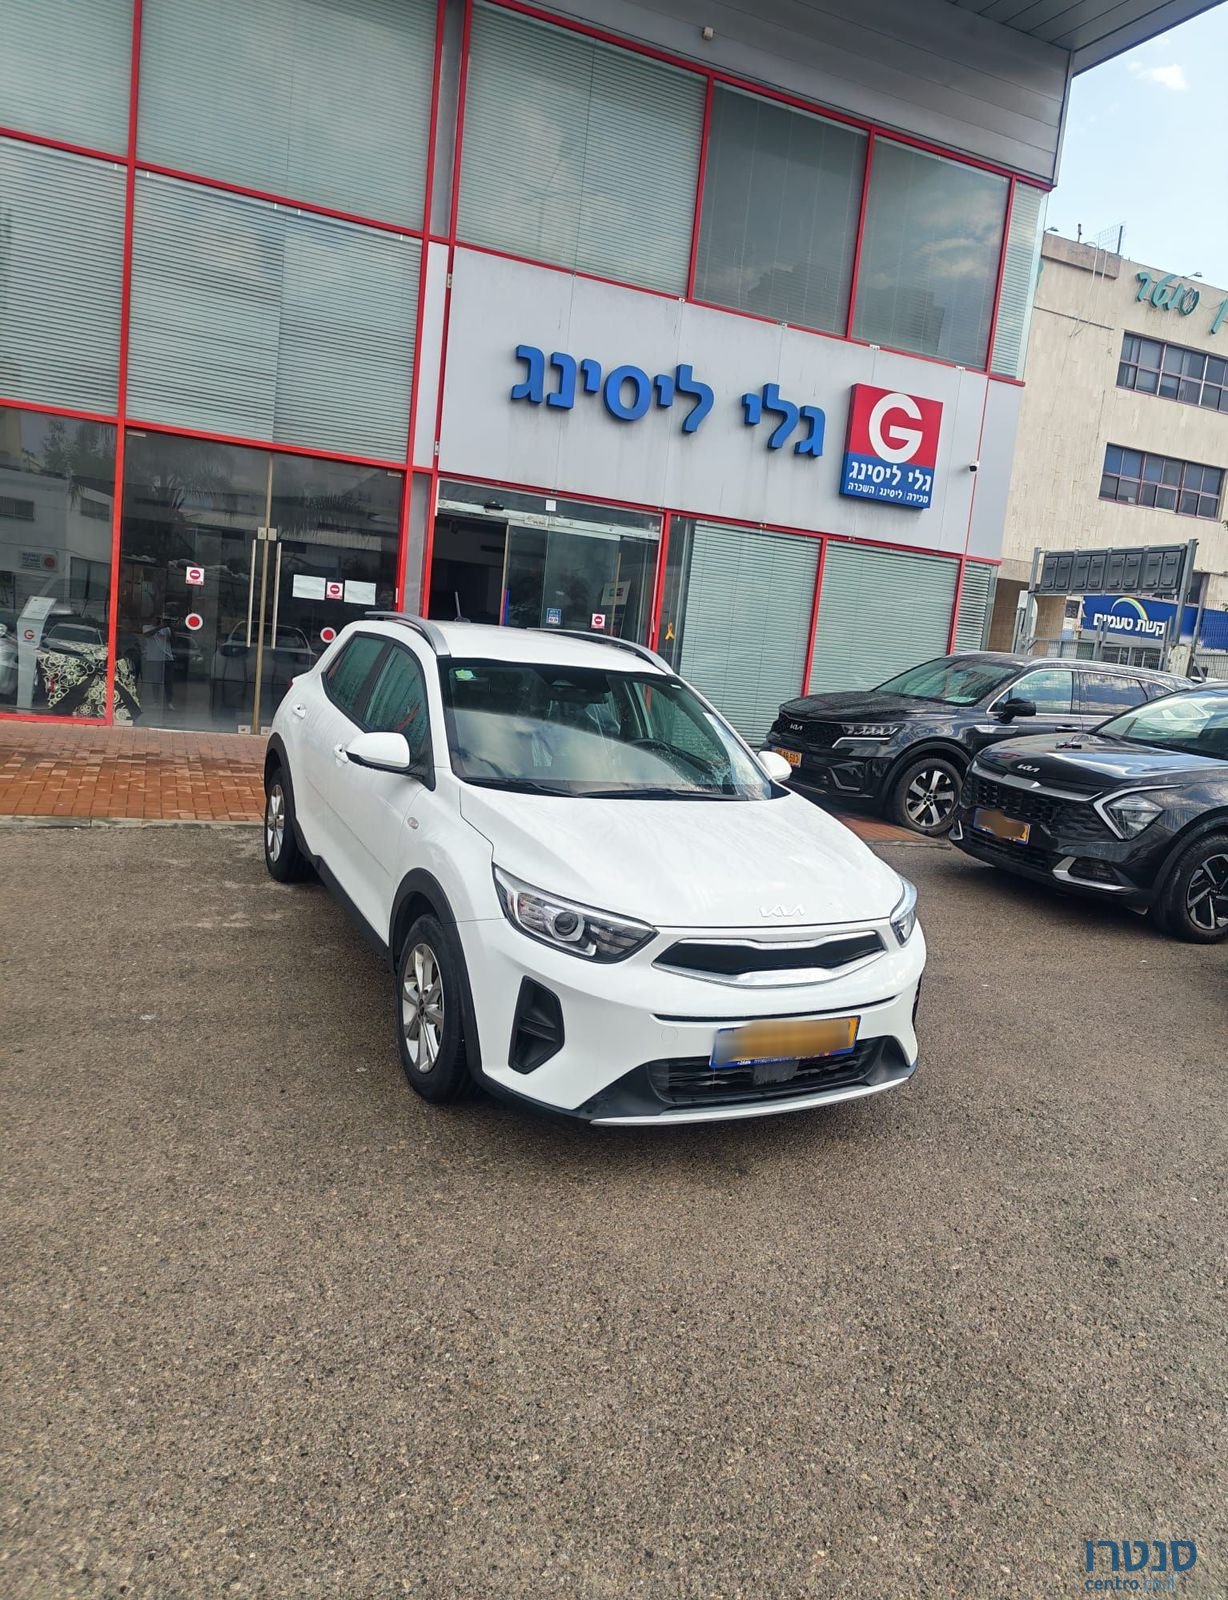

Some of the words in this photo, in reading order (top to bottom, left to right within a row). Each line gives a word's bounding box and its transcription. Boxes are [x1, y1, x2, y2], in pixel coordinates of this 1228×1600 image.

[510, 344, 715, 434] ליסינג
[740, 382, 827, 457] גלי
[868, 392, 923, 464] G
[848, 461, 902, 486] ליסינג
[908, 469, 932, 492] גלי
[847, 481, 875, 494] השכרה
[879, 487, 903, 499] ליסינג
[906, 492, 929, 504] מכירה
[1135, 618, 1165, 637] קשת
